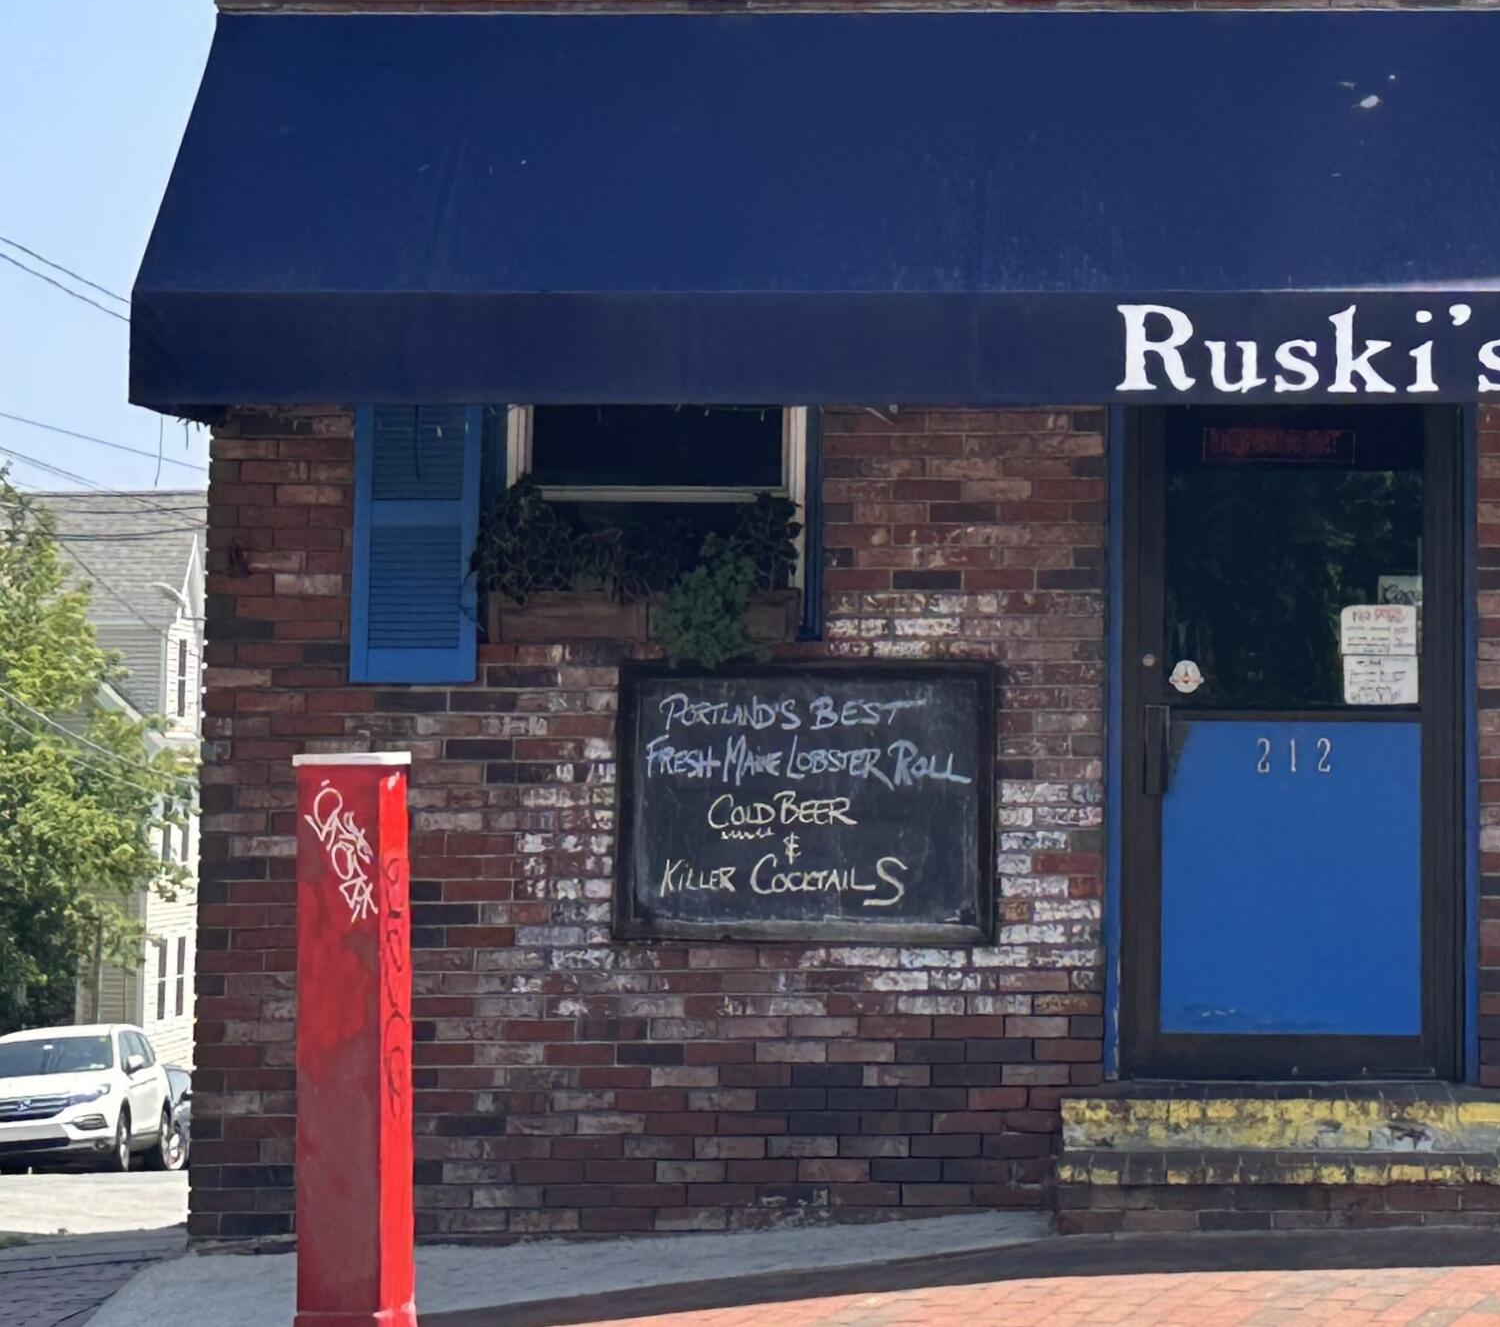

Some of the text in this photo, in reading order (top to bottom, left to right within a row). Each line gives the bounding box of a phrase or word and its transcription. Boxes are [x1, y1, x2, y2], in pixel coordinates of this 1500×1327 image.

[658, 692, 927, 731] PORTLAND'S BEST
[645, 734, 721, 778] FRESH
[786, 734, 895, 791] LOBSTER
[887, 739, 972, 787] ROLL
[707, 790, 858, 829] COLD BEER
[750, 853, 908, 906] COCKTAILS
